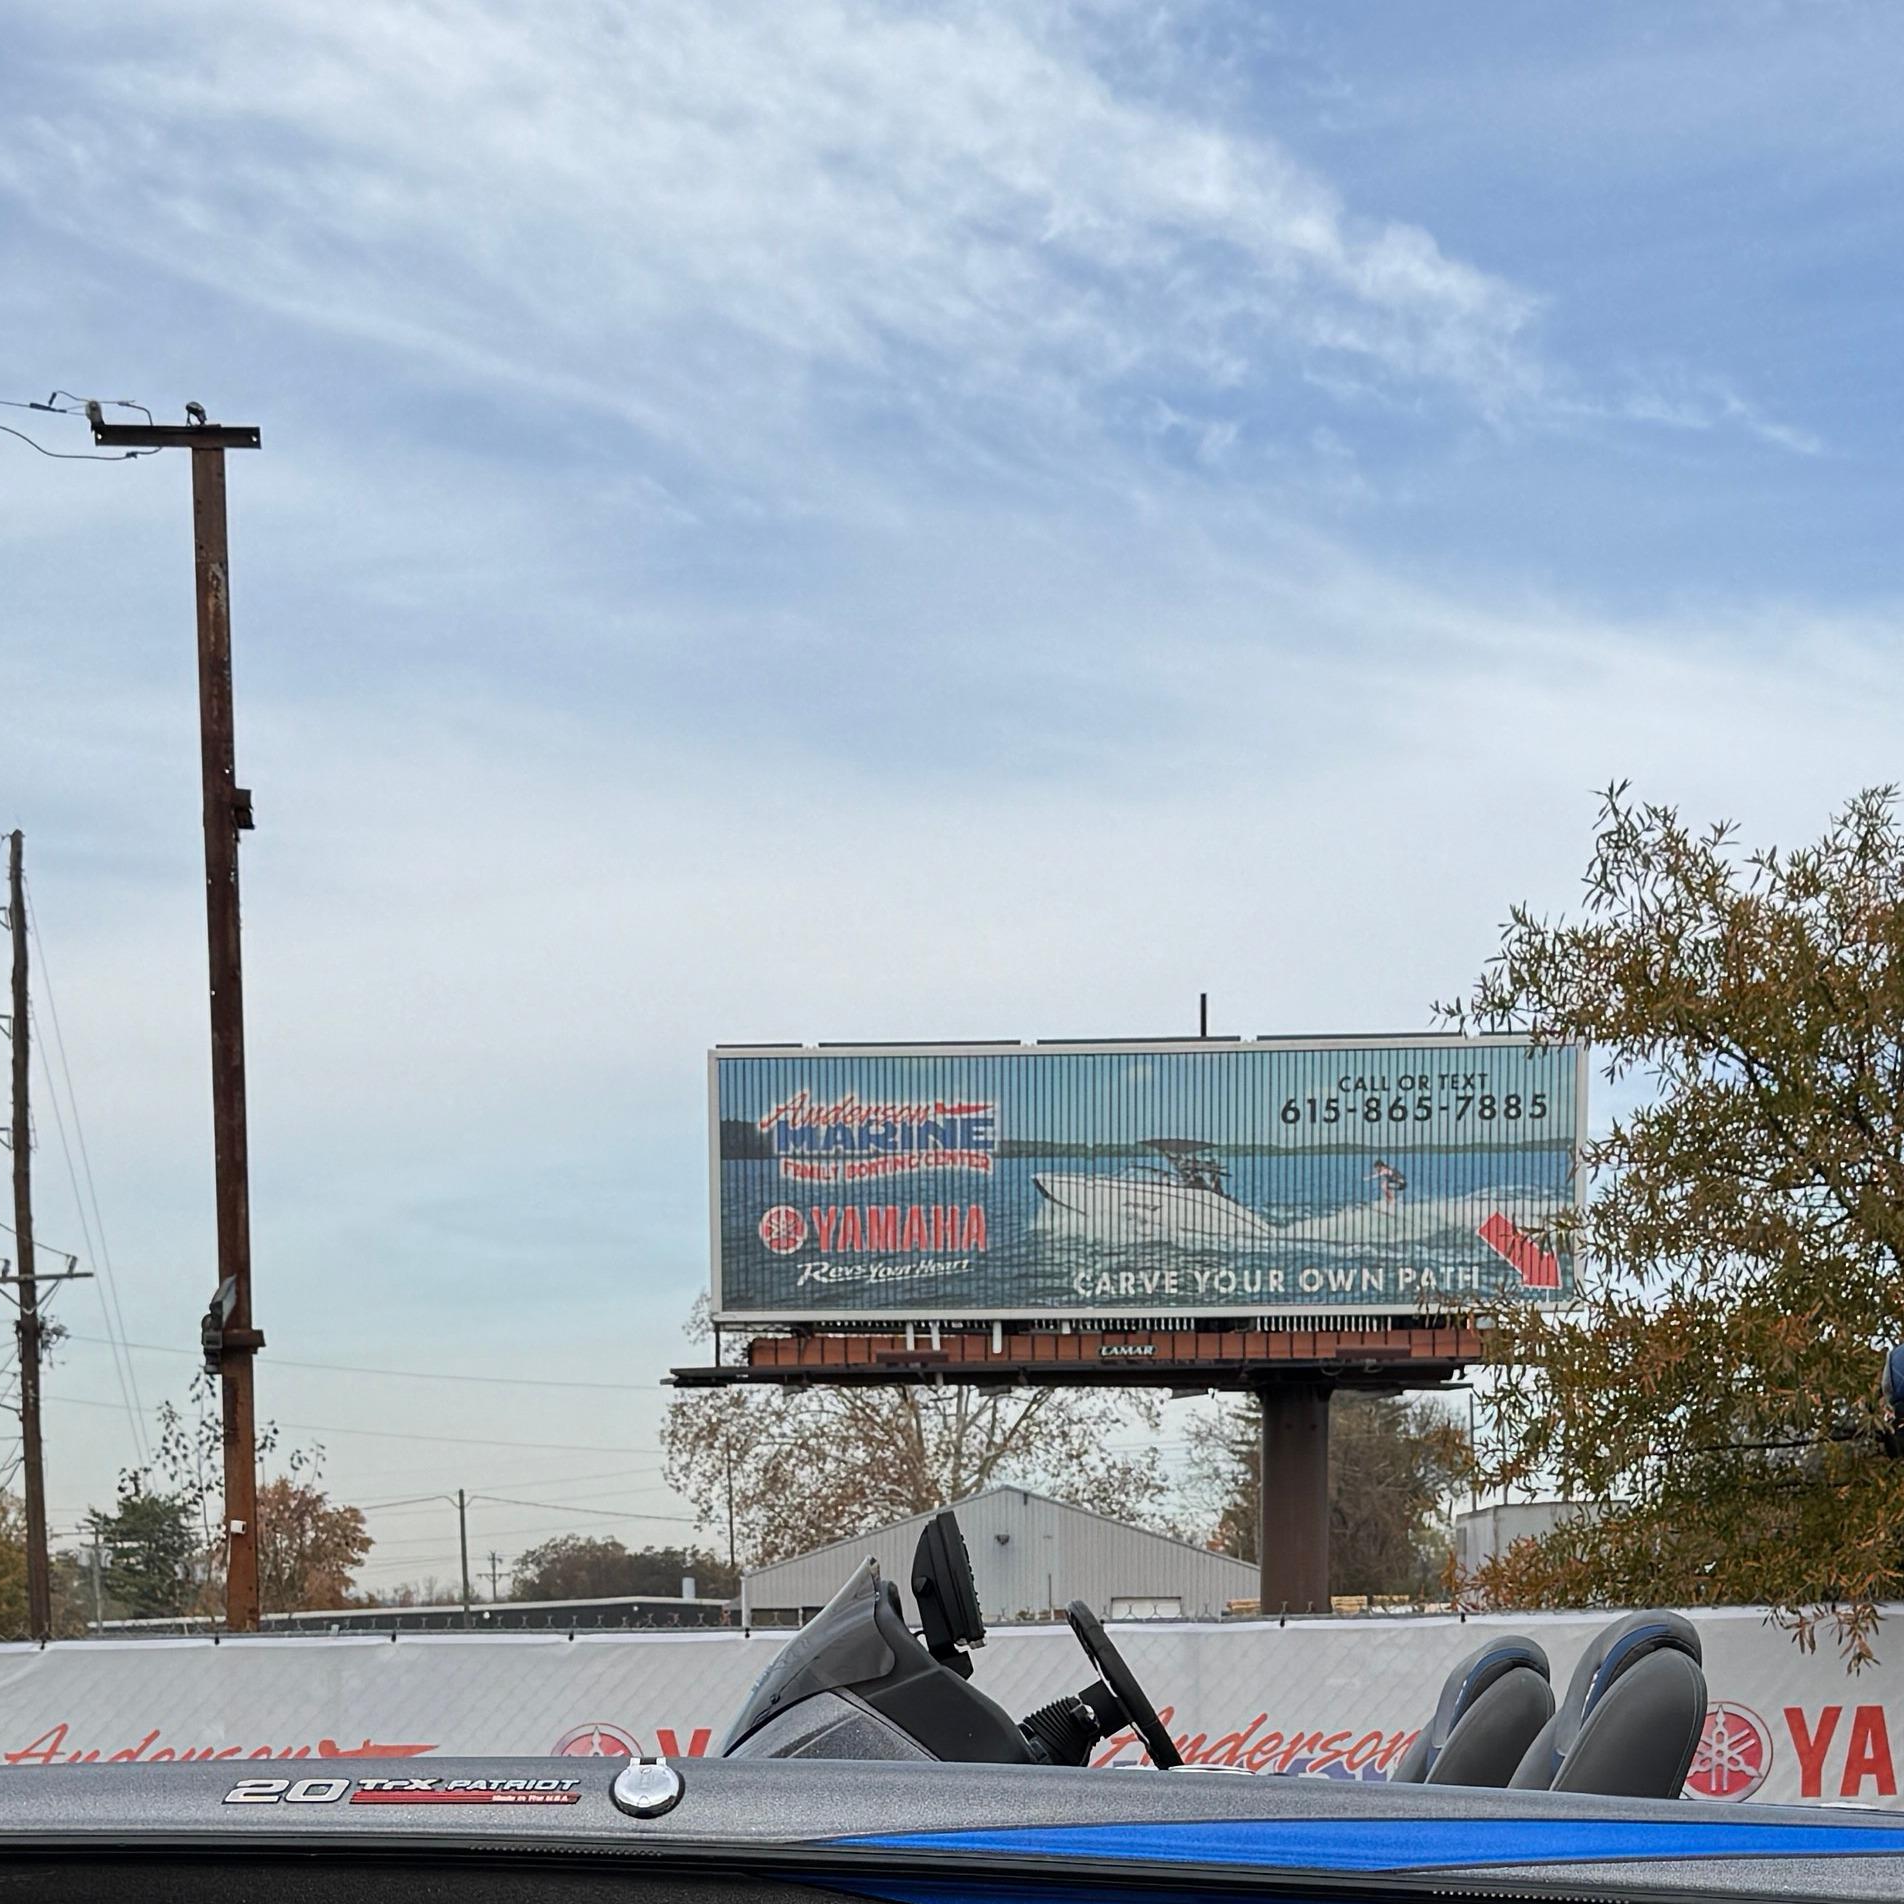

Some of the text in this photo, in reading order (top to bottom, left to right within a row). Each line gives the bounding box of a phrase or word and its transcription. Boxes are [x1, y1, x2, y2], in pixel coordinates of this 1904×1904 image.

[1338, 1073, 1488, 1092] CALL OR TEXT
[1281, 1093, 1547, 1124] 615-865-7885
[776, 1118, 995, 1151] MARINE
[783, 1151, 991, 1180] FAMILY BOATING CENTER
[811, 1205, 987, 1252] YAMAHA
[796, 1258, 974, 1286] Revs Your Heart
[1073, 1265, 1480, 1296] CARVE YOUR OWN PATH
[1101, 1346, 1153, 1356] LAMAR
[224, 1779, 350, 1803] 20
[446, 1779, 582, 1791] PATRIOT
